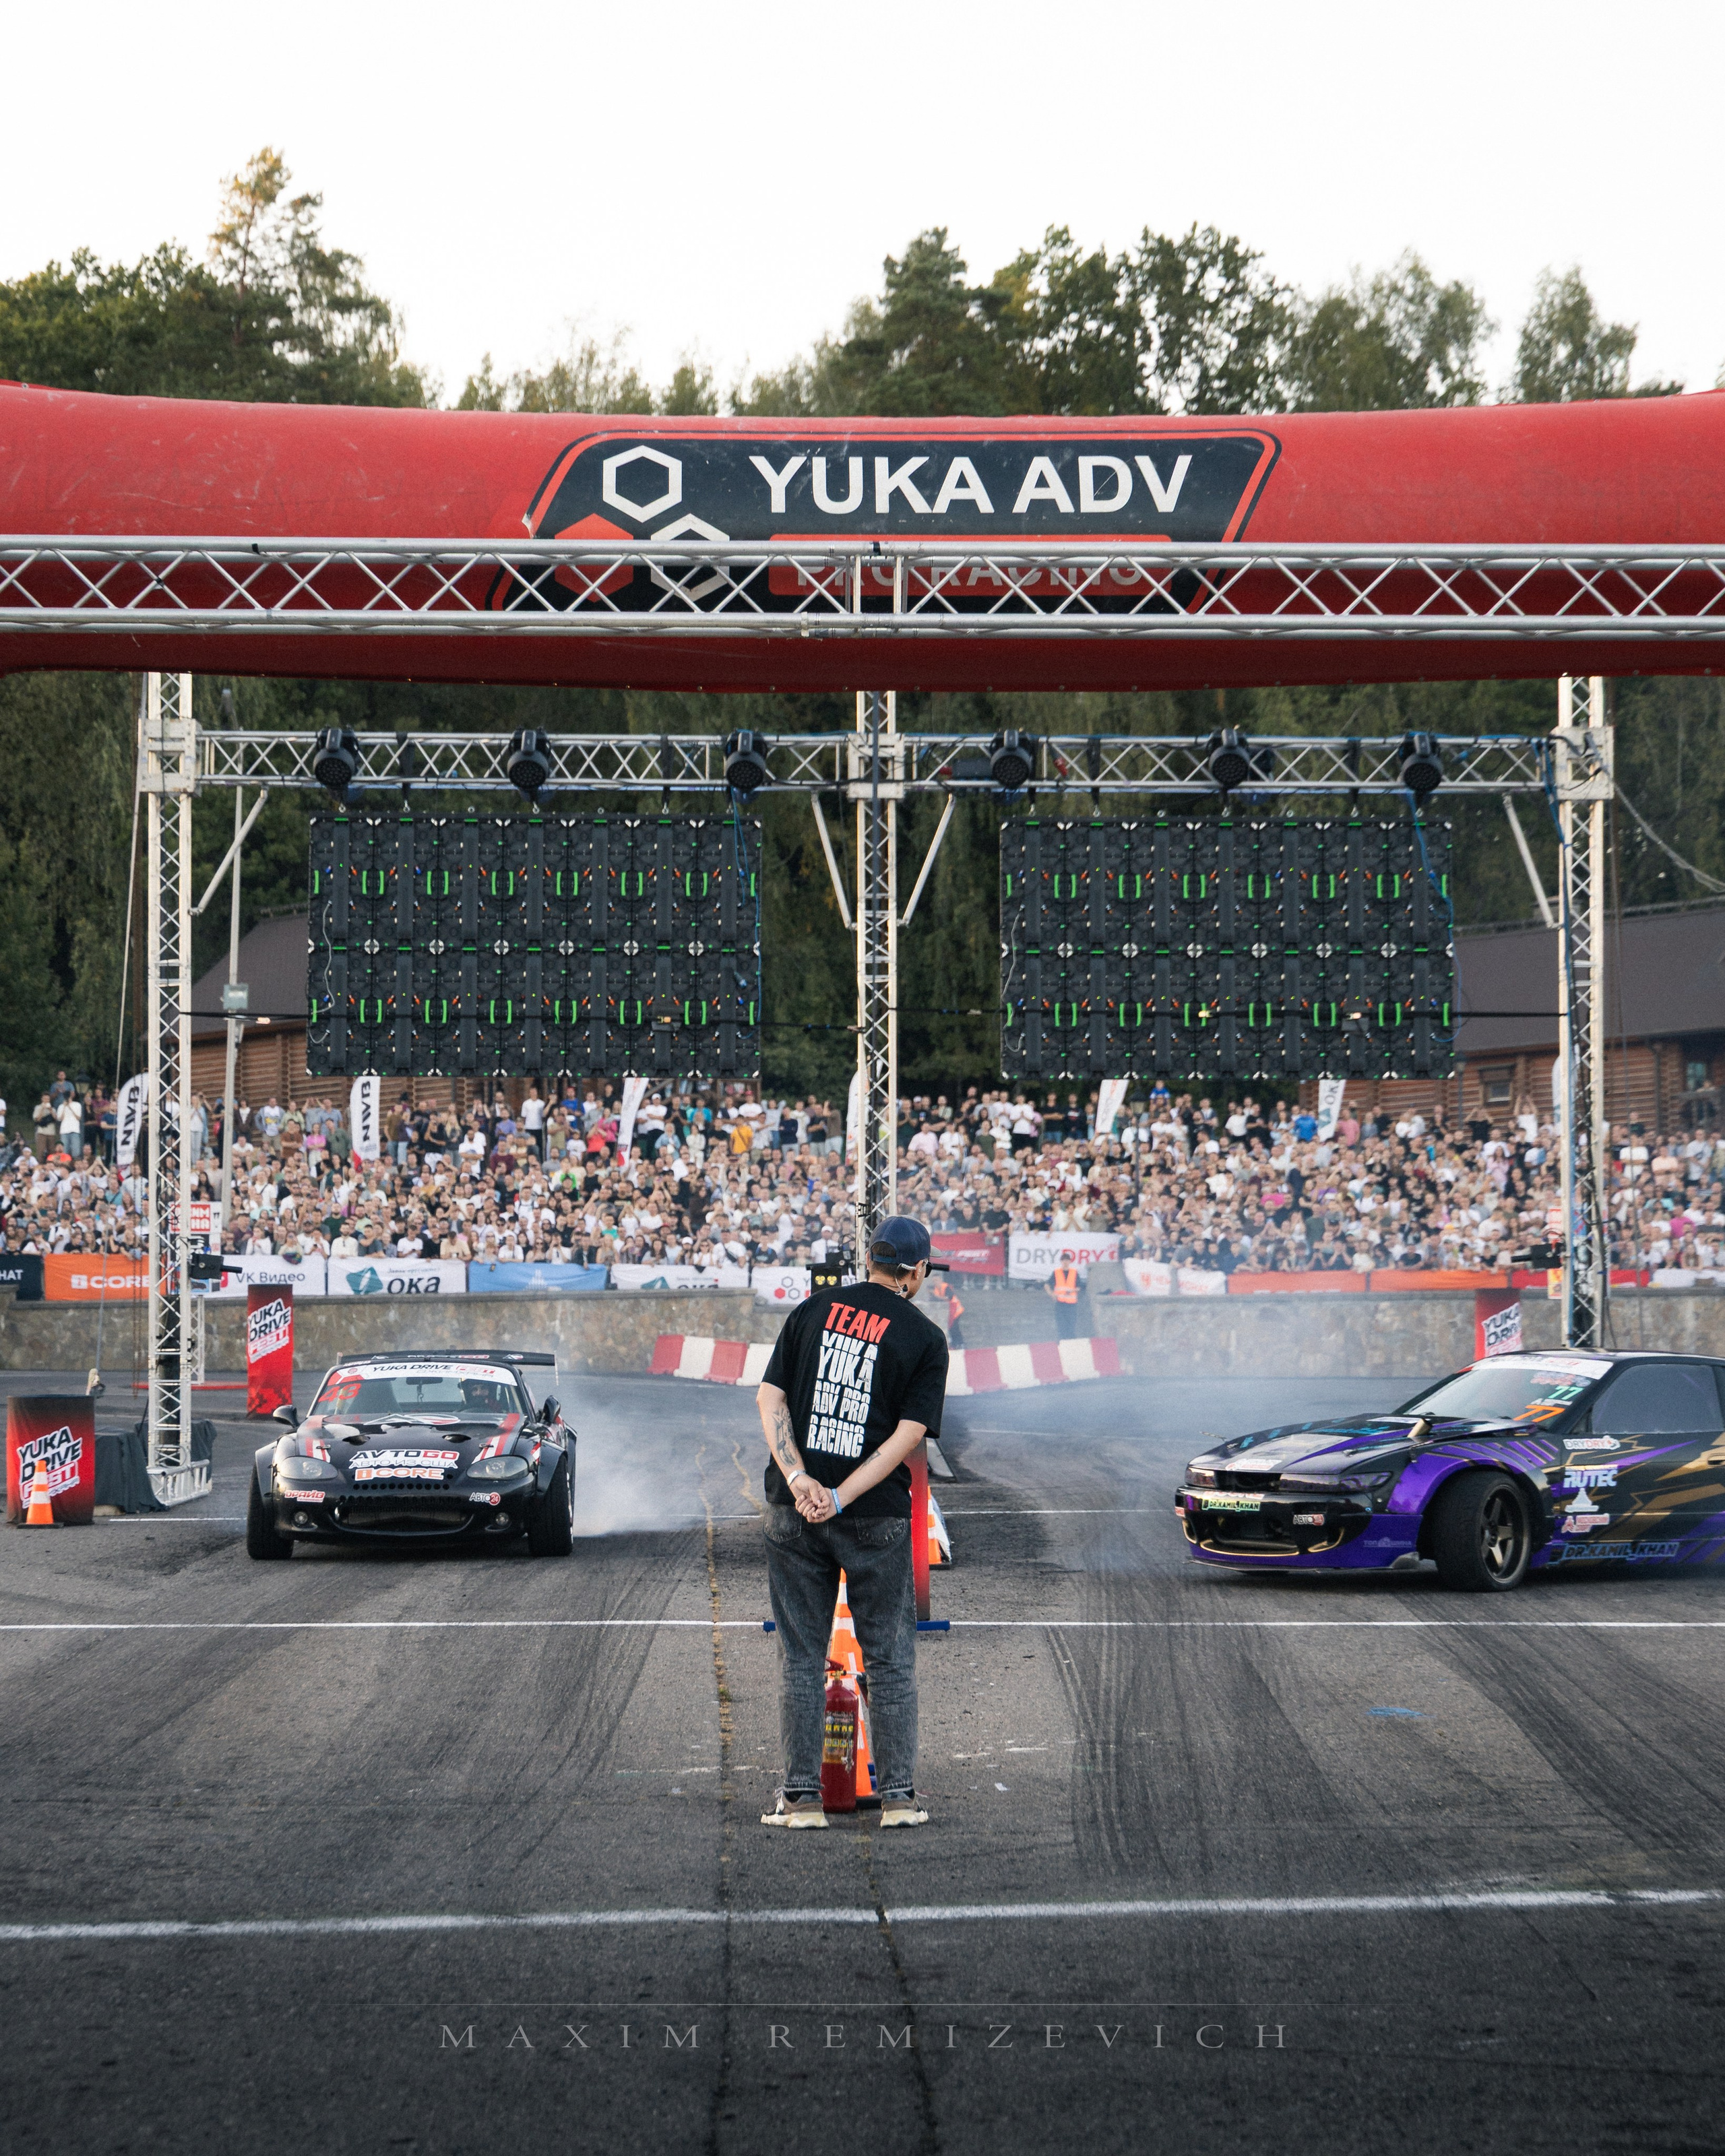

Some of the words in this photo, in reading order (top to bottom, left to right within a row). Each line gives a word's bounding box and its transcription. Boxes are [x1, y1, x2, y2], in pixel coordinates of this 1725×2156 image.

[749, 454, 995, 515] YUKA
[1012, 454, 1193, 515] ADV
[237, 1272, 255, 1283] VK
[261, 1272, 305, 1285] Видео
[249, 1301, 284, 1325] YUKA
[249, 1310, 290, 1342] DRIVE
[825, 1302, 891, 1343] TEAM
[372, 1364, 407, 1372] YUKA
[817, 1345, 875, 1393] YUKA
[1548, 1386, 1584, 1400] 77
[812, 1391, 839, 1416] ADV
[839, 1397, 869, 1424] PRO
[1513, 1405, 1566, 1422] 77
[19, 1428, 71, 1463] YUKA
[807, 1424, 864, 1458] RACING
[1565, 1440, 1606, 1449] DRYDRY
[352, 1460, 393, 1468] АВТО
[376, 1469, 443, 1478] CORE
[23, 1462, 76, 1498] FST
